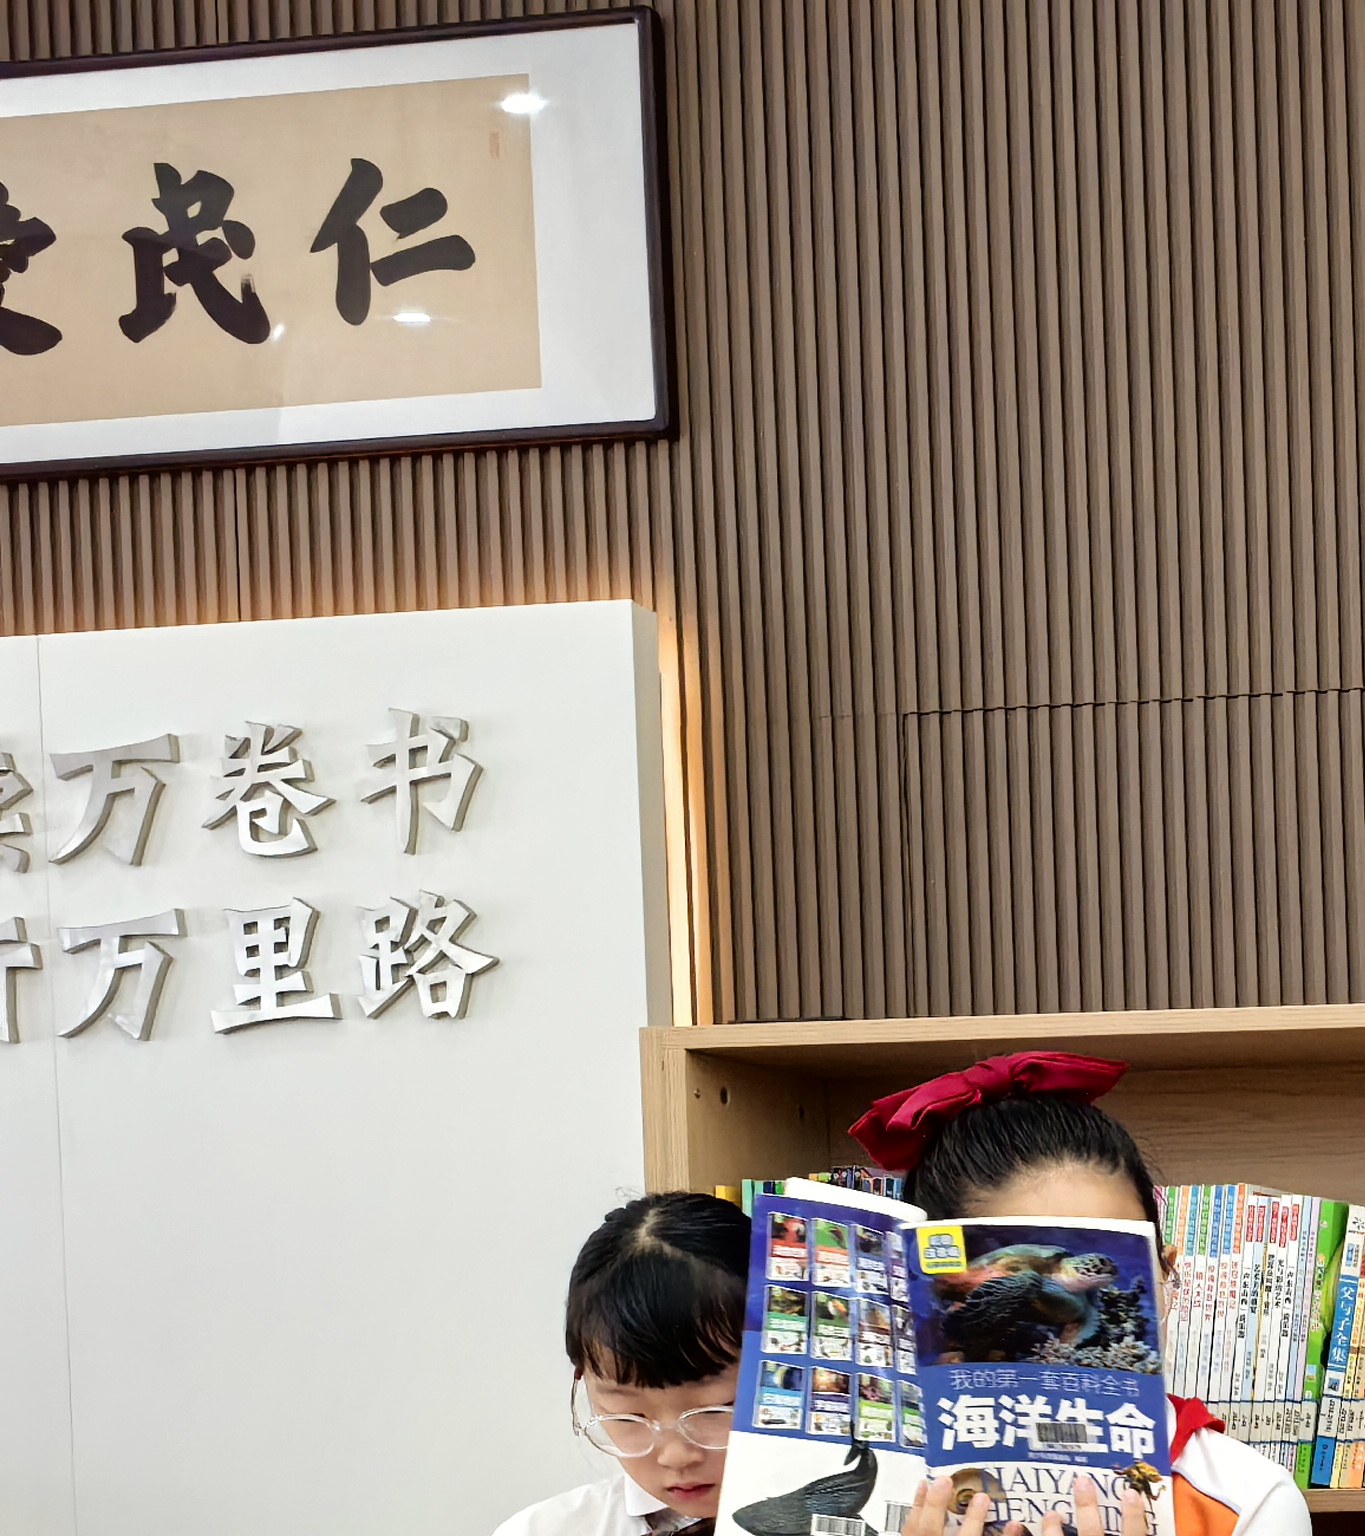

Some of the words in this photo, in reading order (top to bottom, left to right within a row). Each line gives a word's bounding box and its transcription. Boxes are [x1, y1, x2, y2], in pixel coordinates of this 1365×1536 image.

[0, 708, 485, 873] 万卷书
[1331, 1285, 1356, 1364] 父与子全集
[949, 1369, 1140, 1398] 我的第一套百科全书
[937, 1394, 1157, 1459] 海洋生命
